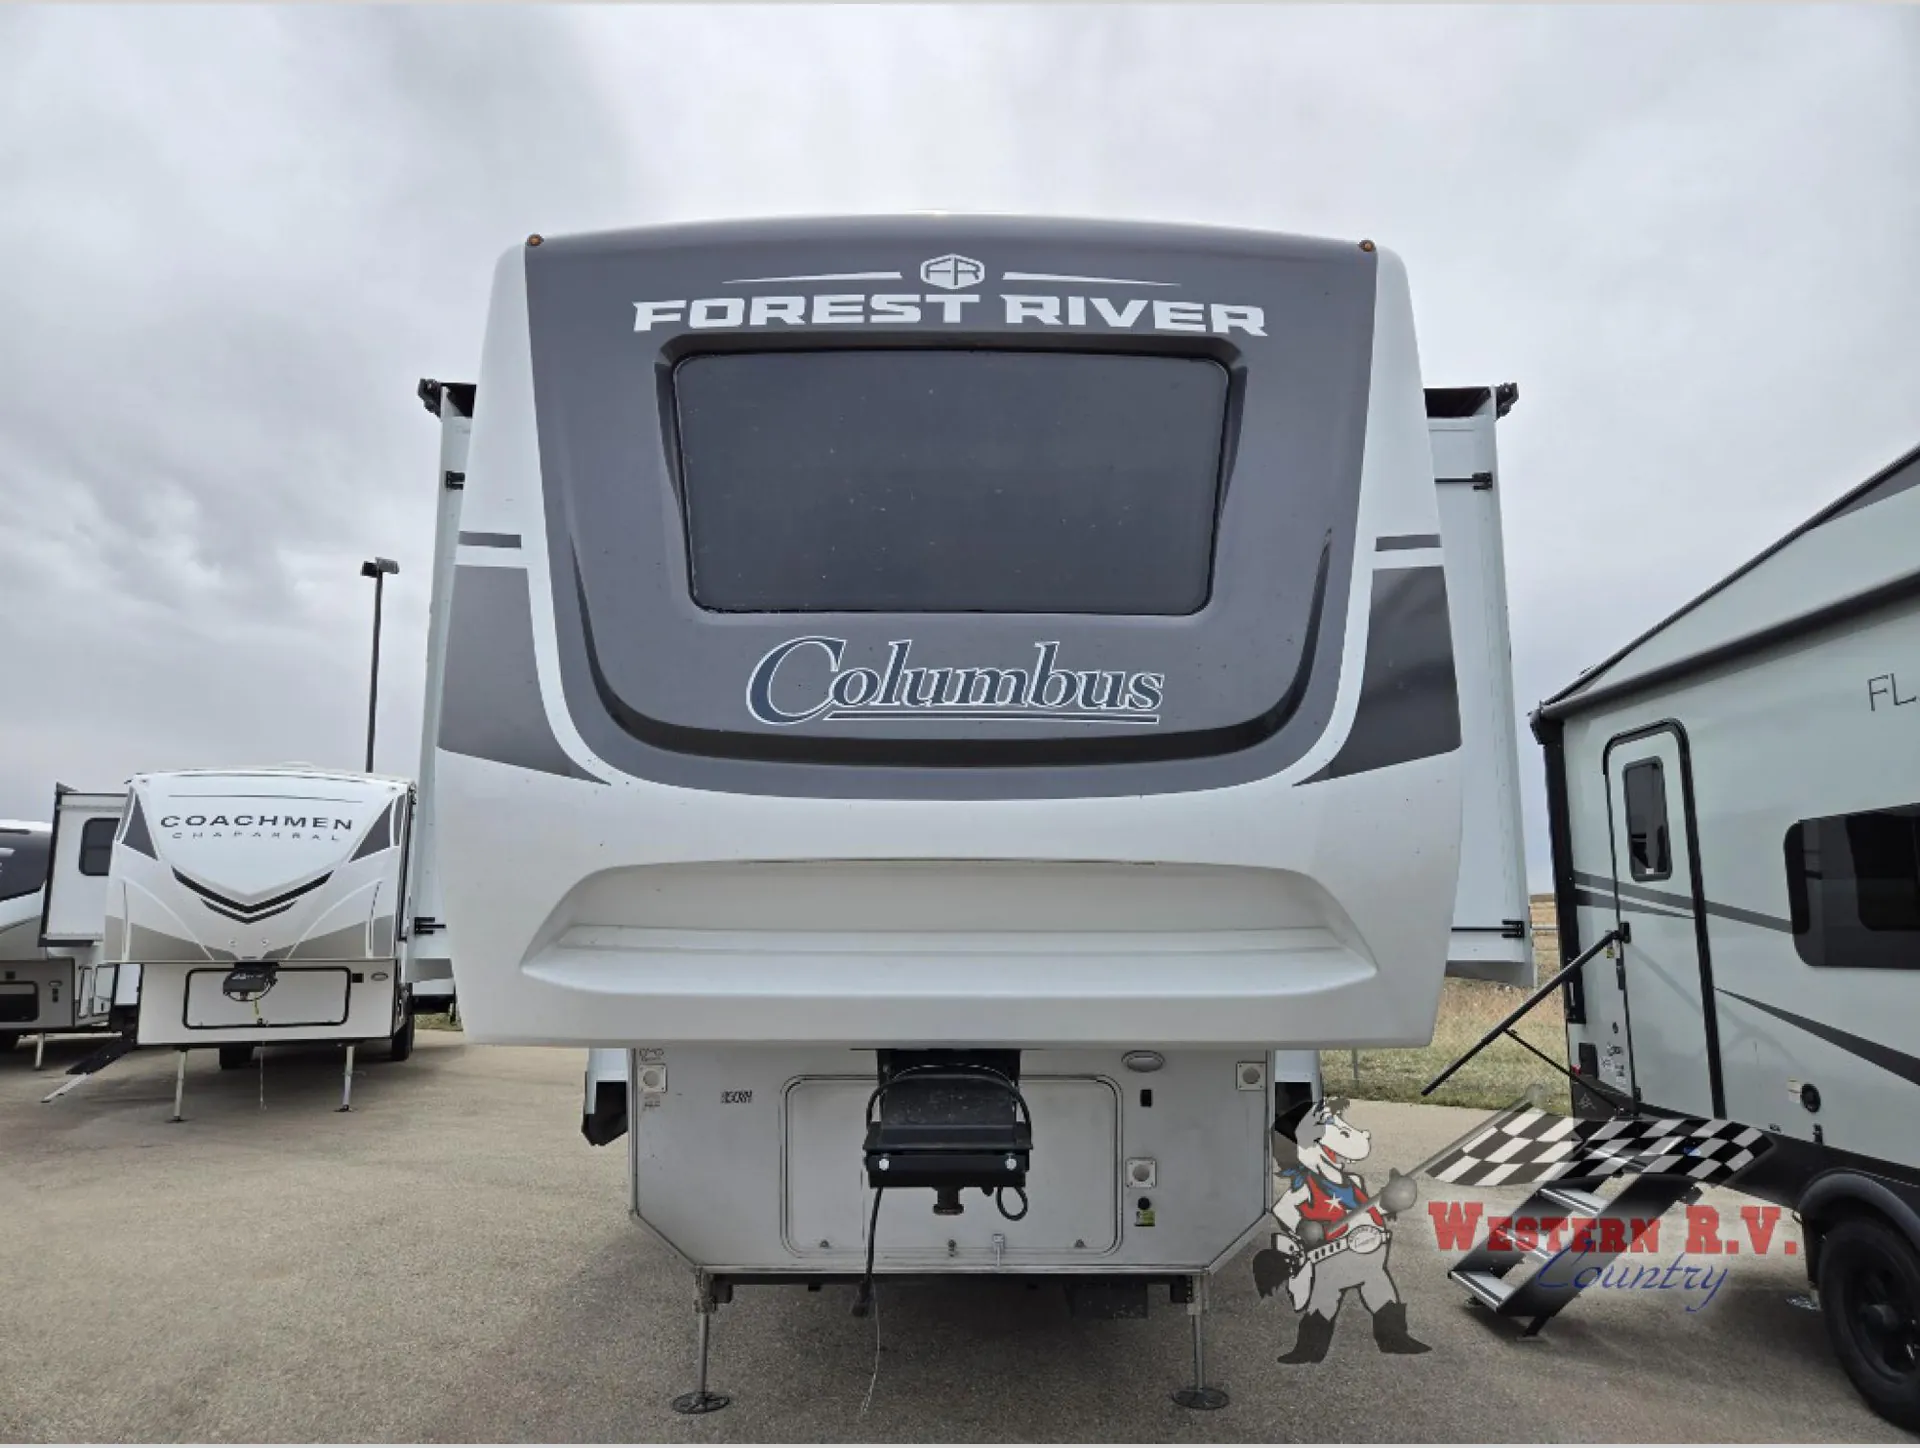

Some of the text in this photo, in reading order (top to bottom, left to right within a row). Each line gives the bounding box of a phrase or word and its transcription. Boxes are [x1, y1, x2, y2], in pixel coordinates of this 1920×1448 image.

[632, 293, 1269, 337] FOREST RIVER
[746, 635, 1165, 725] Columbus
[160, 815, 352, 830] COACHMEN
[172, 831, 340, 842] CHAPARRAL
